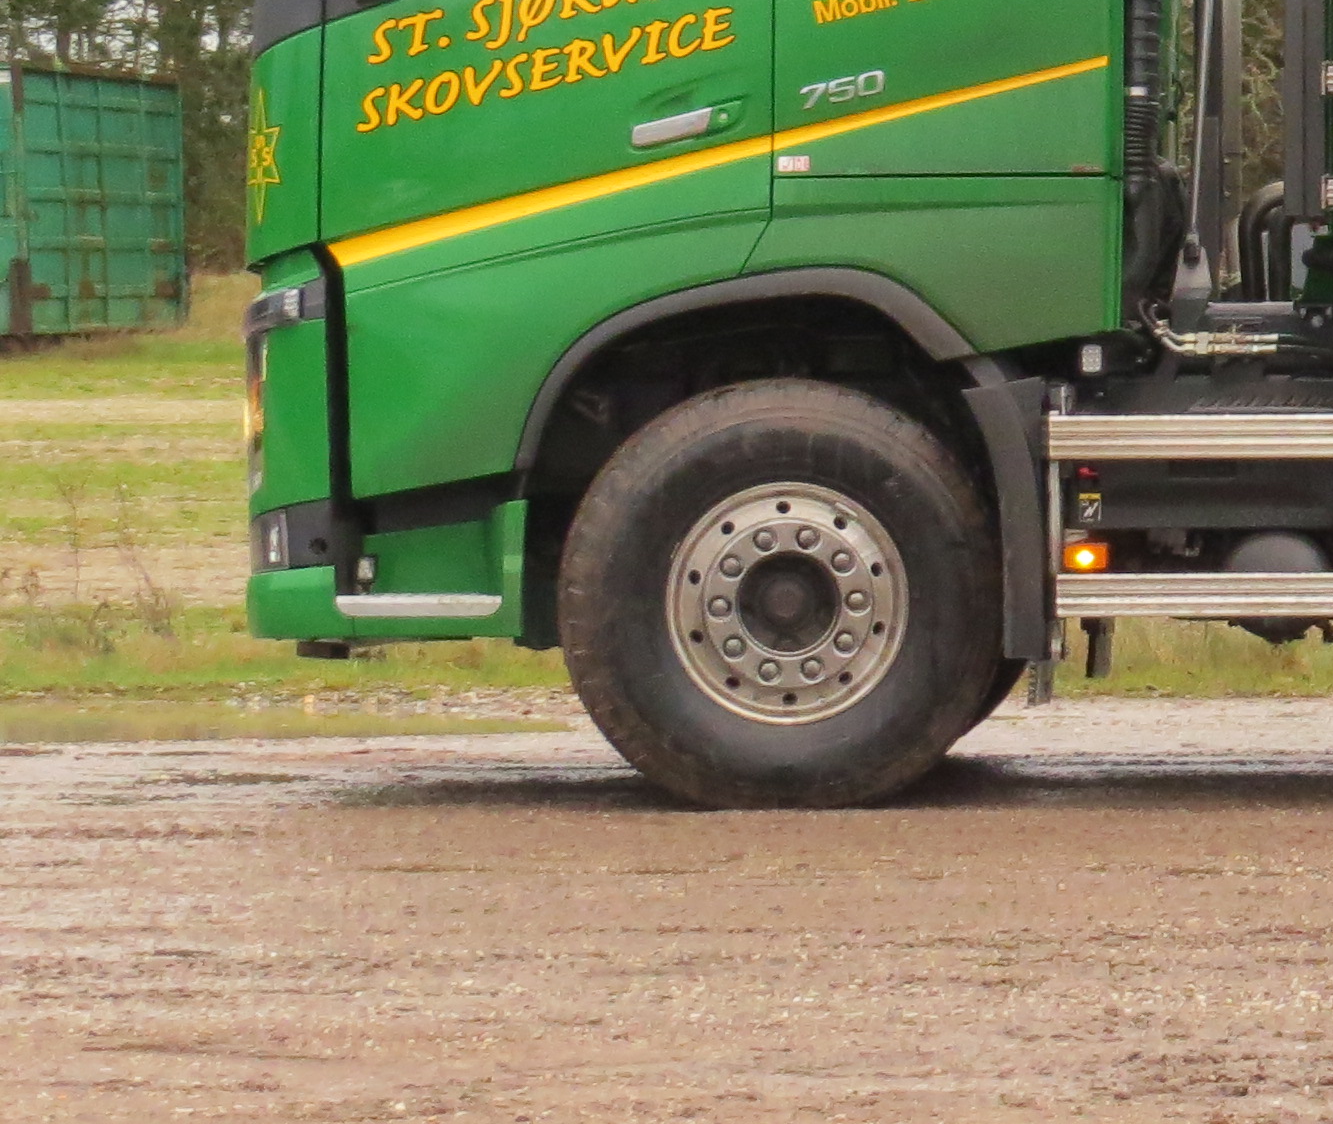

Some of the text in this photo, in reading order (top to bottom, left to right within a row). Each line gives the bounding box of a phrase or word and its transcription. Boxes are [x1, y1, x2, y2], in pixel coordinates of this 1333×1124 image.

[366, 8, 452, 65] ST.
[356, 7, 736, 133] SKOVSERVICE
[799, 69, 886, 110] 750
